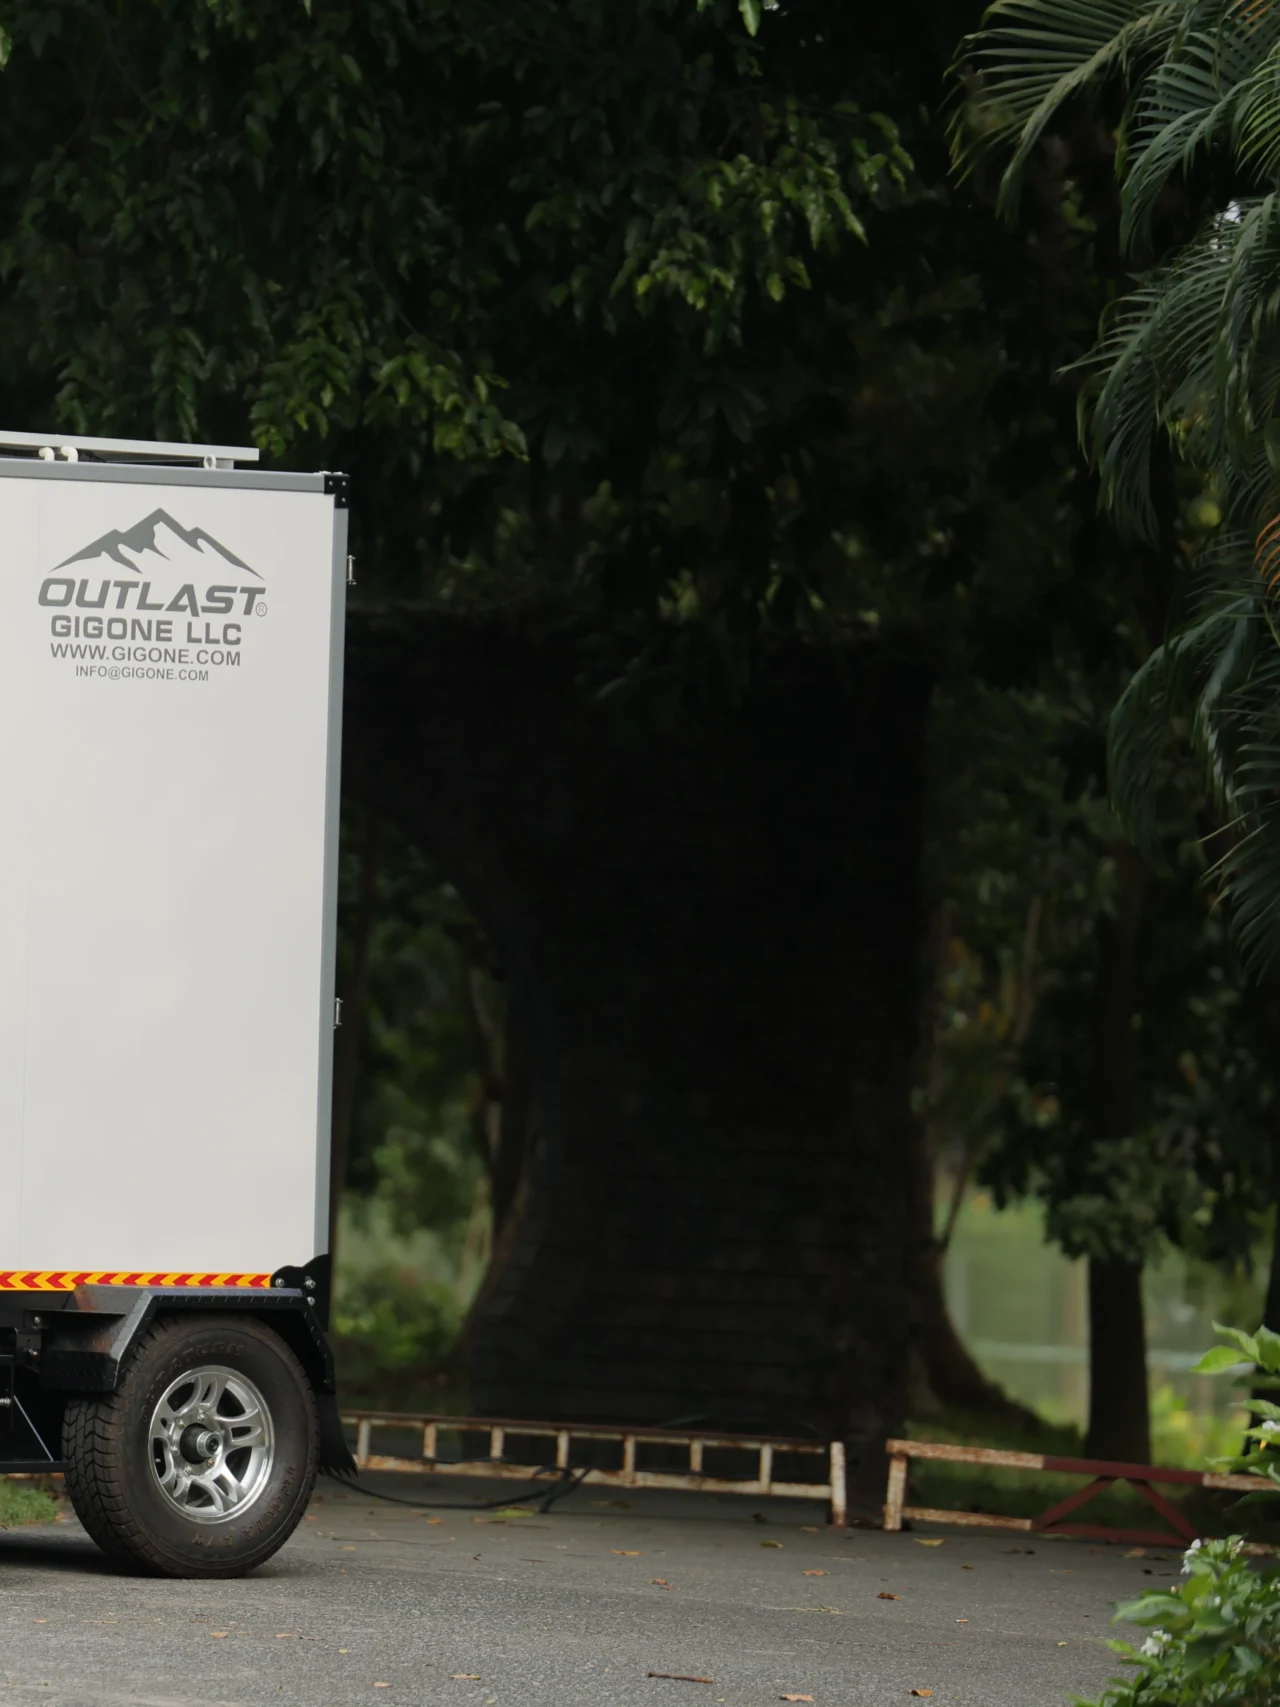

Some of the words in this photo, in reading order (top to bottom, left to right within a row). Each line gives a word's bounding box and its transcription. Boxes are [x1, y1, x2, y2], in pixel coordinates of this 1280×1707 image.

[51, 614, 173, 643] GIGONE
[186, 621, 242, 646] LLC
[50, 642, 241, 667] WWW.GIGONE.COM
[75, 665, 209, 682] INFO@GIGONE.COM
